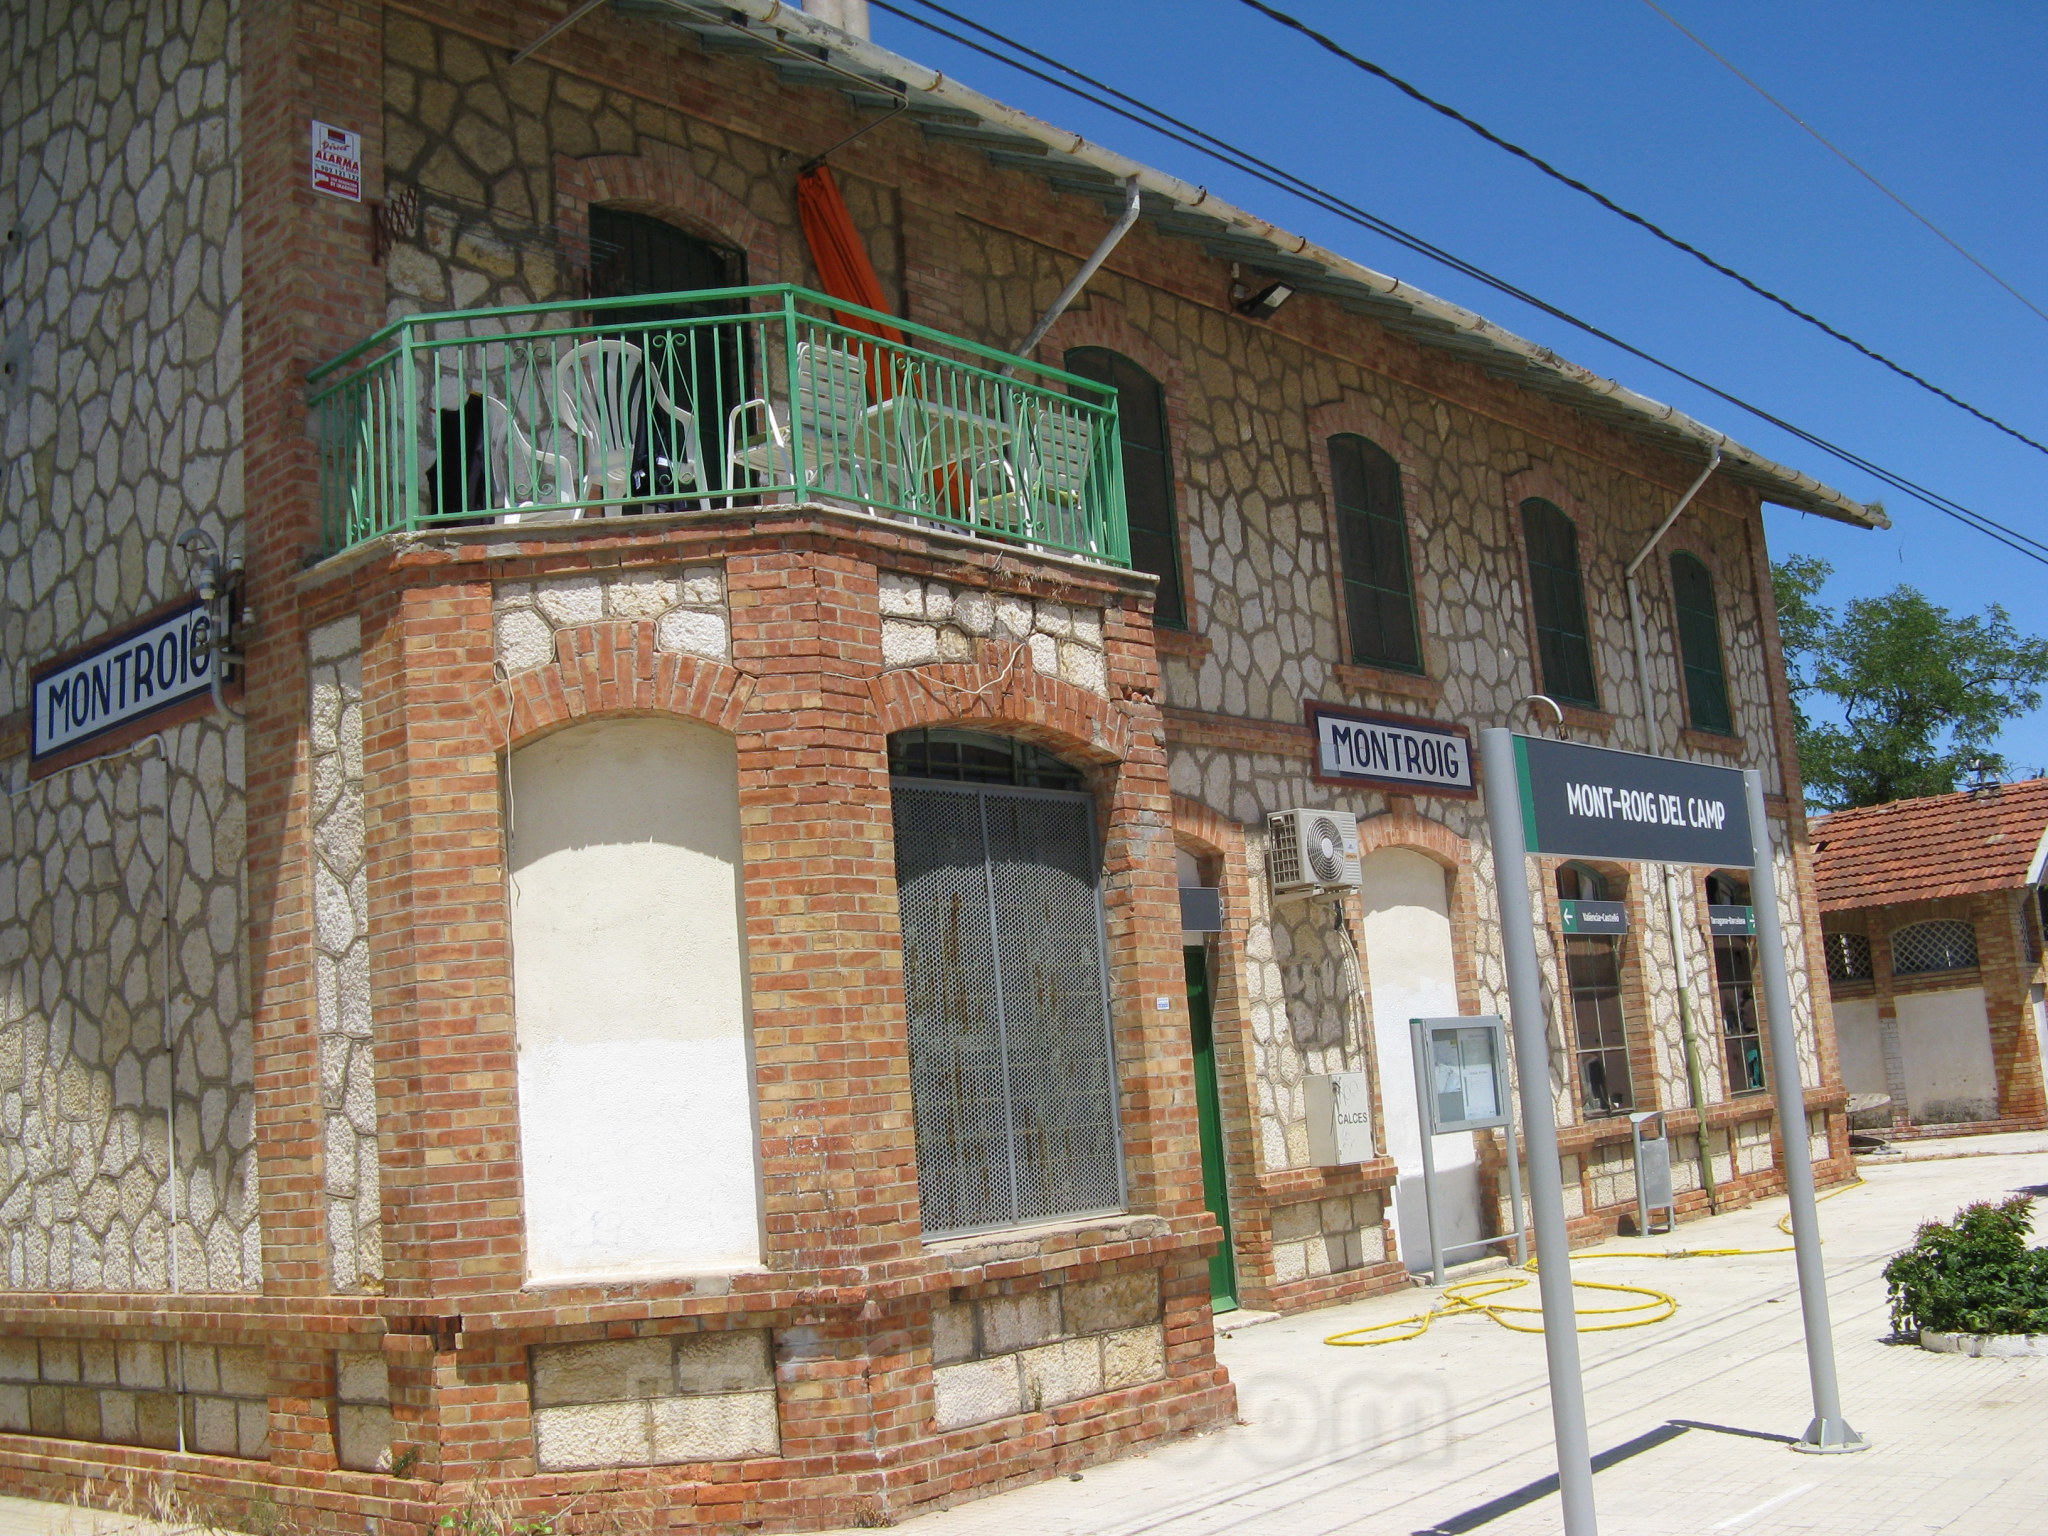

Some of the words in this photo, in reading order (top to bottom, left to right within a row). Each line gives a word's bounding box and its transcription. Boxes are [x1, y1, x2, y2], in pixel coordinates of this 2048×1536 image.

[315, 150, 359, 171] ALARMA
[1332, 725, 1459, 778] MONTROIG
[1566, 782, 1658, 823] MONT-ROIG
[1659, 794, 1687, 826] DEL
[1688, 797, 1726, 830] CAMP
[1338, 1112, 1368, 1125] CALCES
